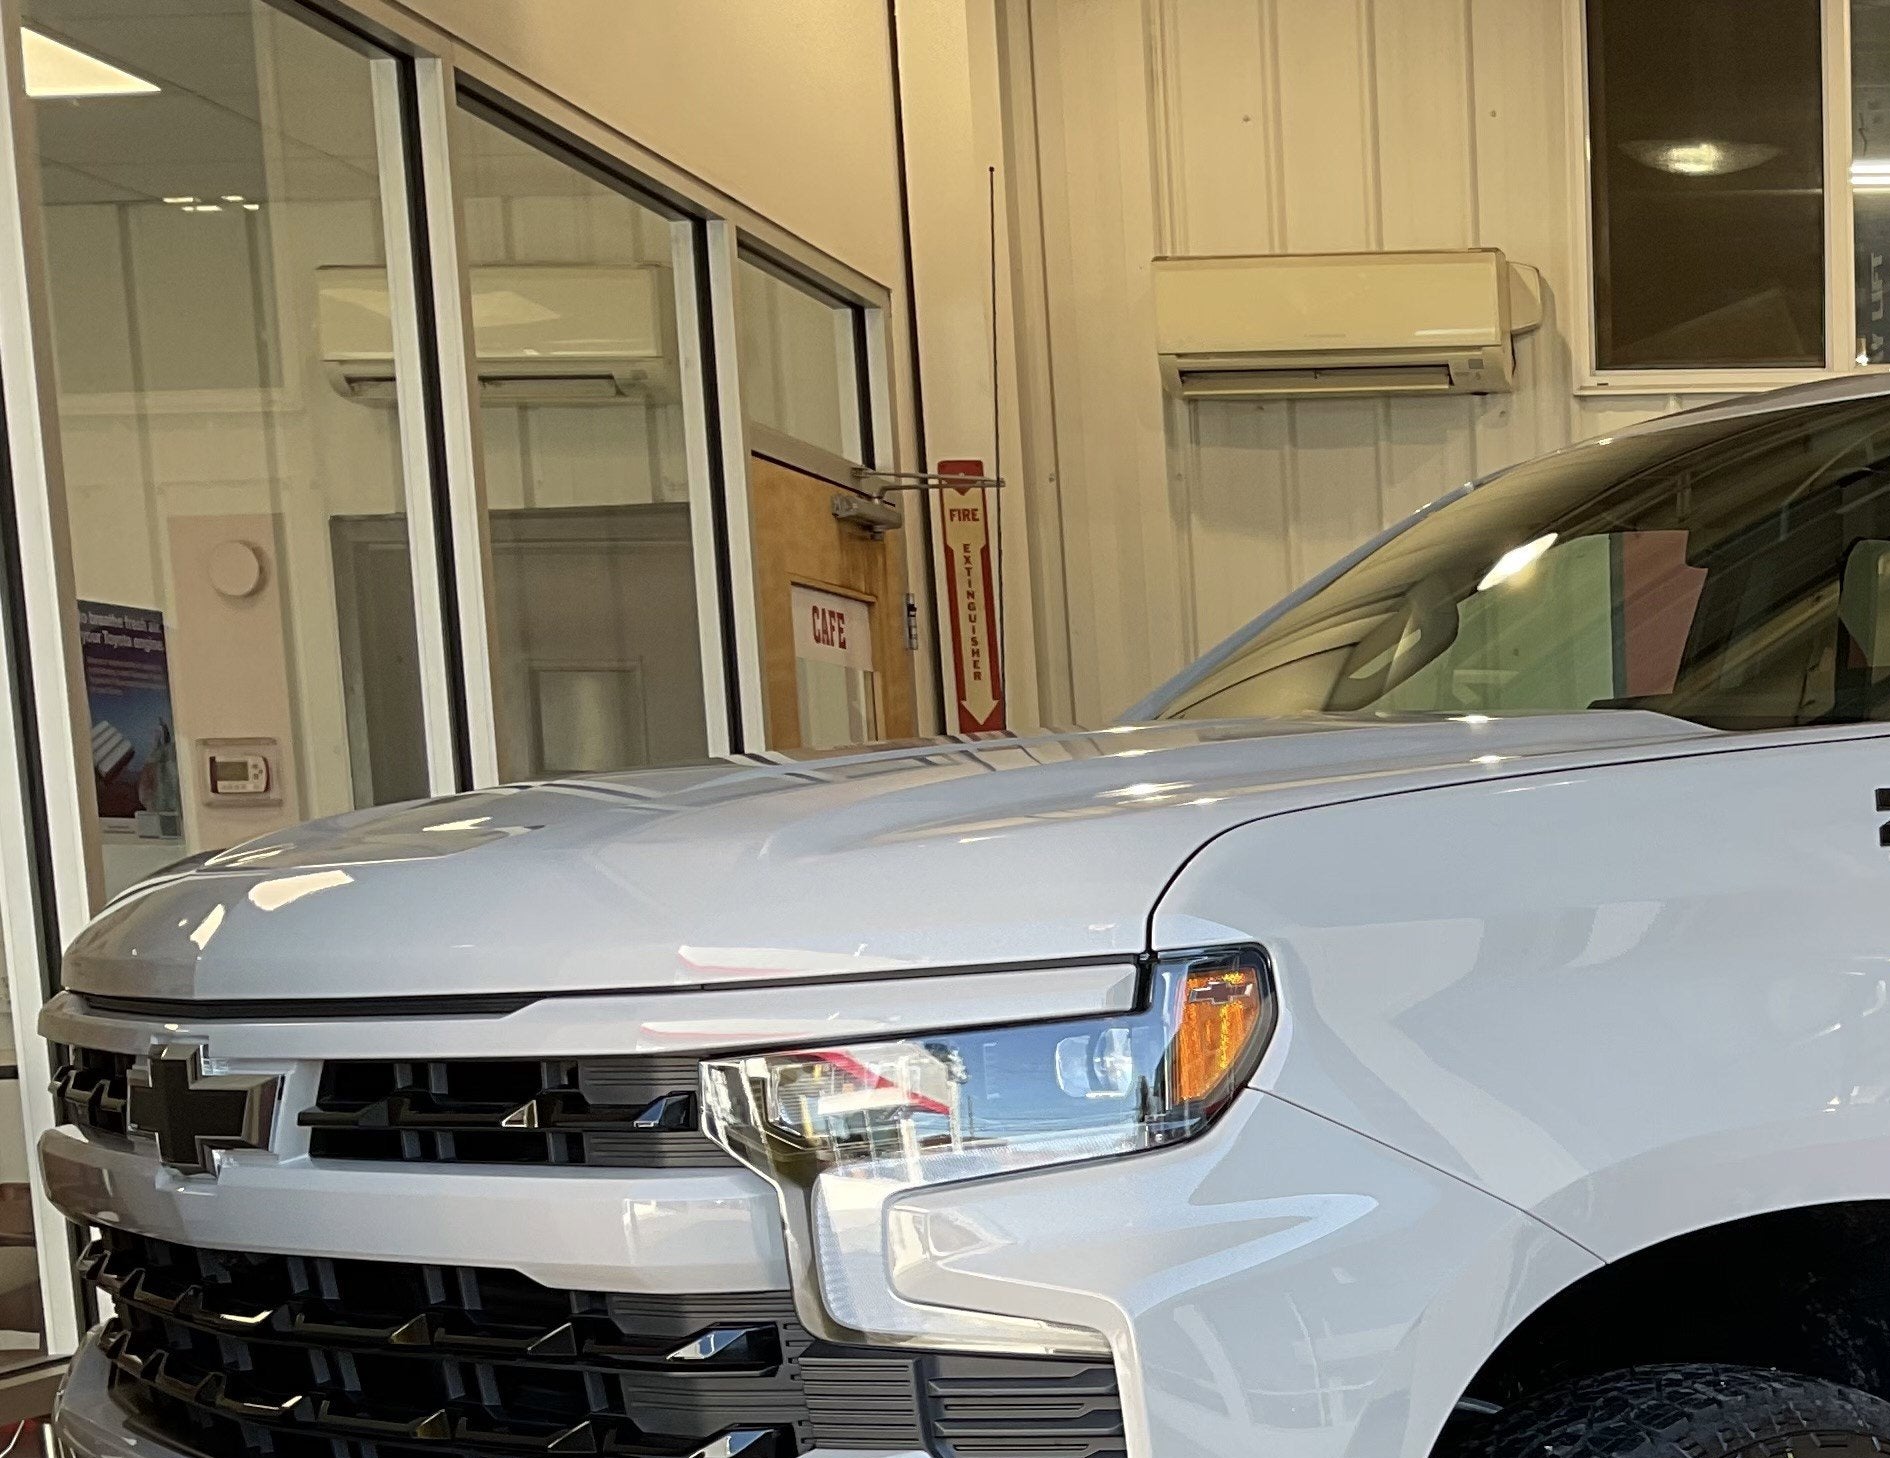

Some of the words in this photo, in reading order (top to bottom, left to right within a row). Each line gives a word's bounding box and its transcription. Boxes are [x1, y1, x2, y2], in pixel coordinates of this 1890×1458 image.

[1870, 252, 1884, 321] LIFT
[949, 507, 980, 522] FIRE
[811, 604, 847, 650] CAFE
[962, 542, 983, 681] EXTINGUISHER
[102, 630, 132, 648] Toyota
